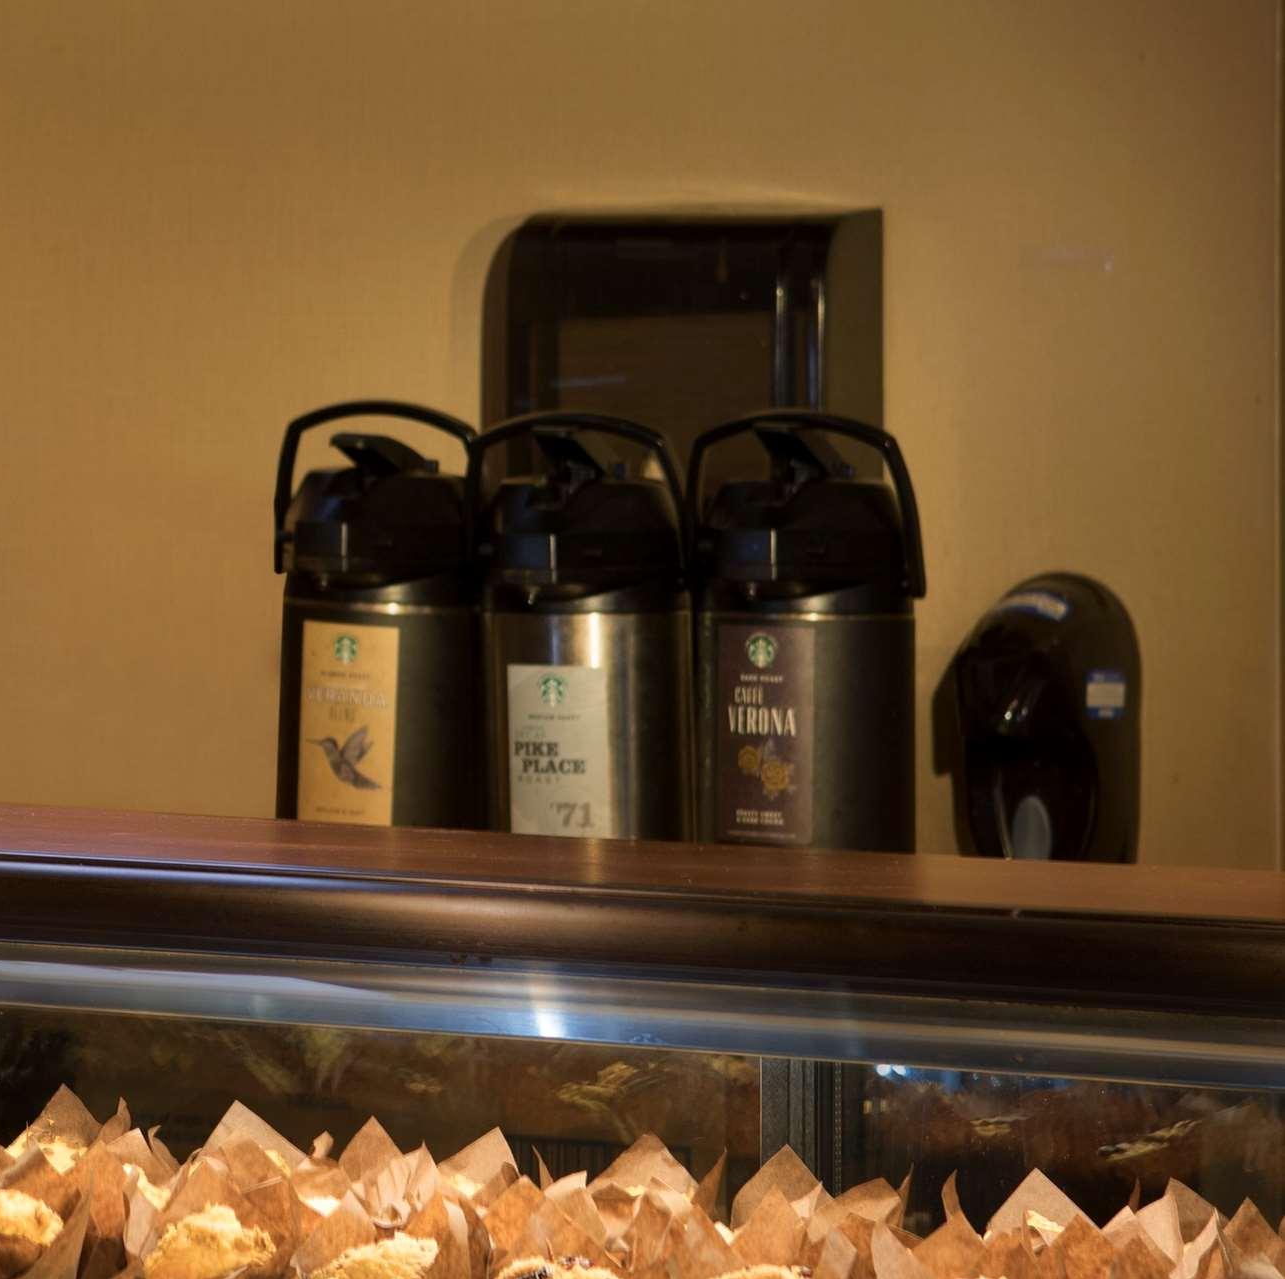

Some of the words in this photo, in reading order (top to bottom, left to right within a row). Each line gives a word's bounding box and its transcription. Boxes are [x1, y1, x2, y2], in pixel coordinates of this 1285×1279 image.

[727, 704, 797, 738] VERONA
[514, 740, 560, 757] PIKE
[521, 758, 587, 775] PLACE
